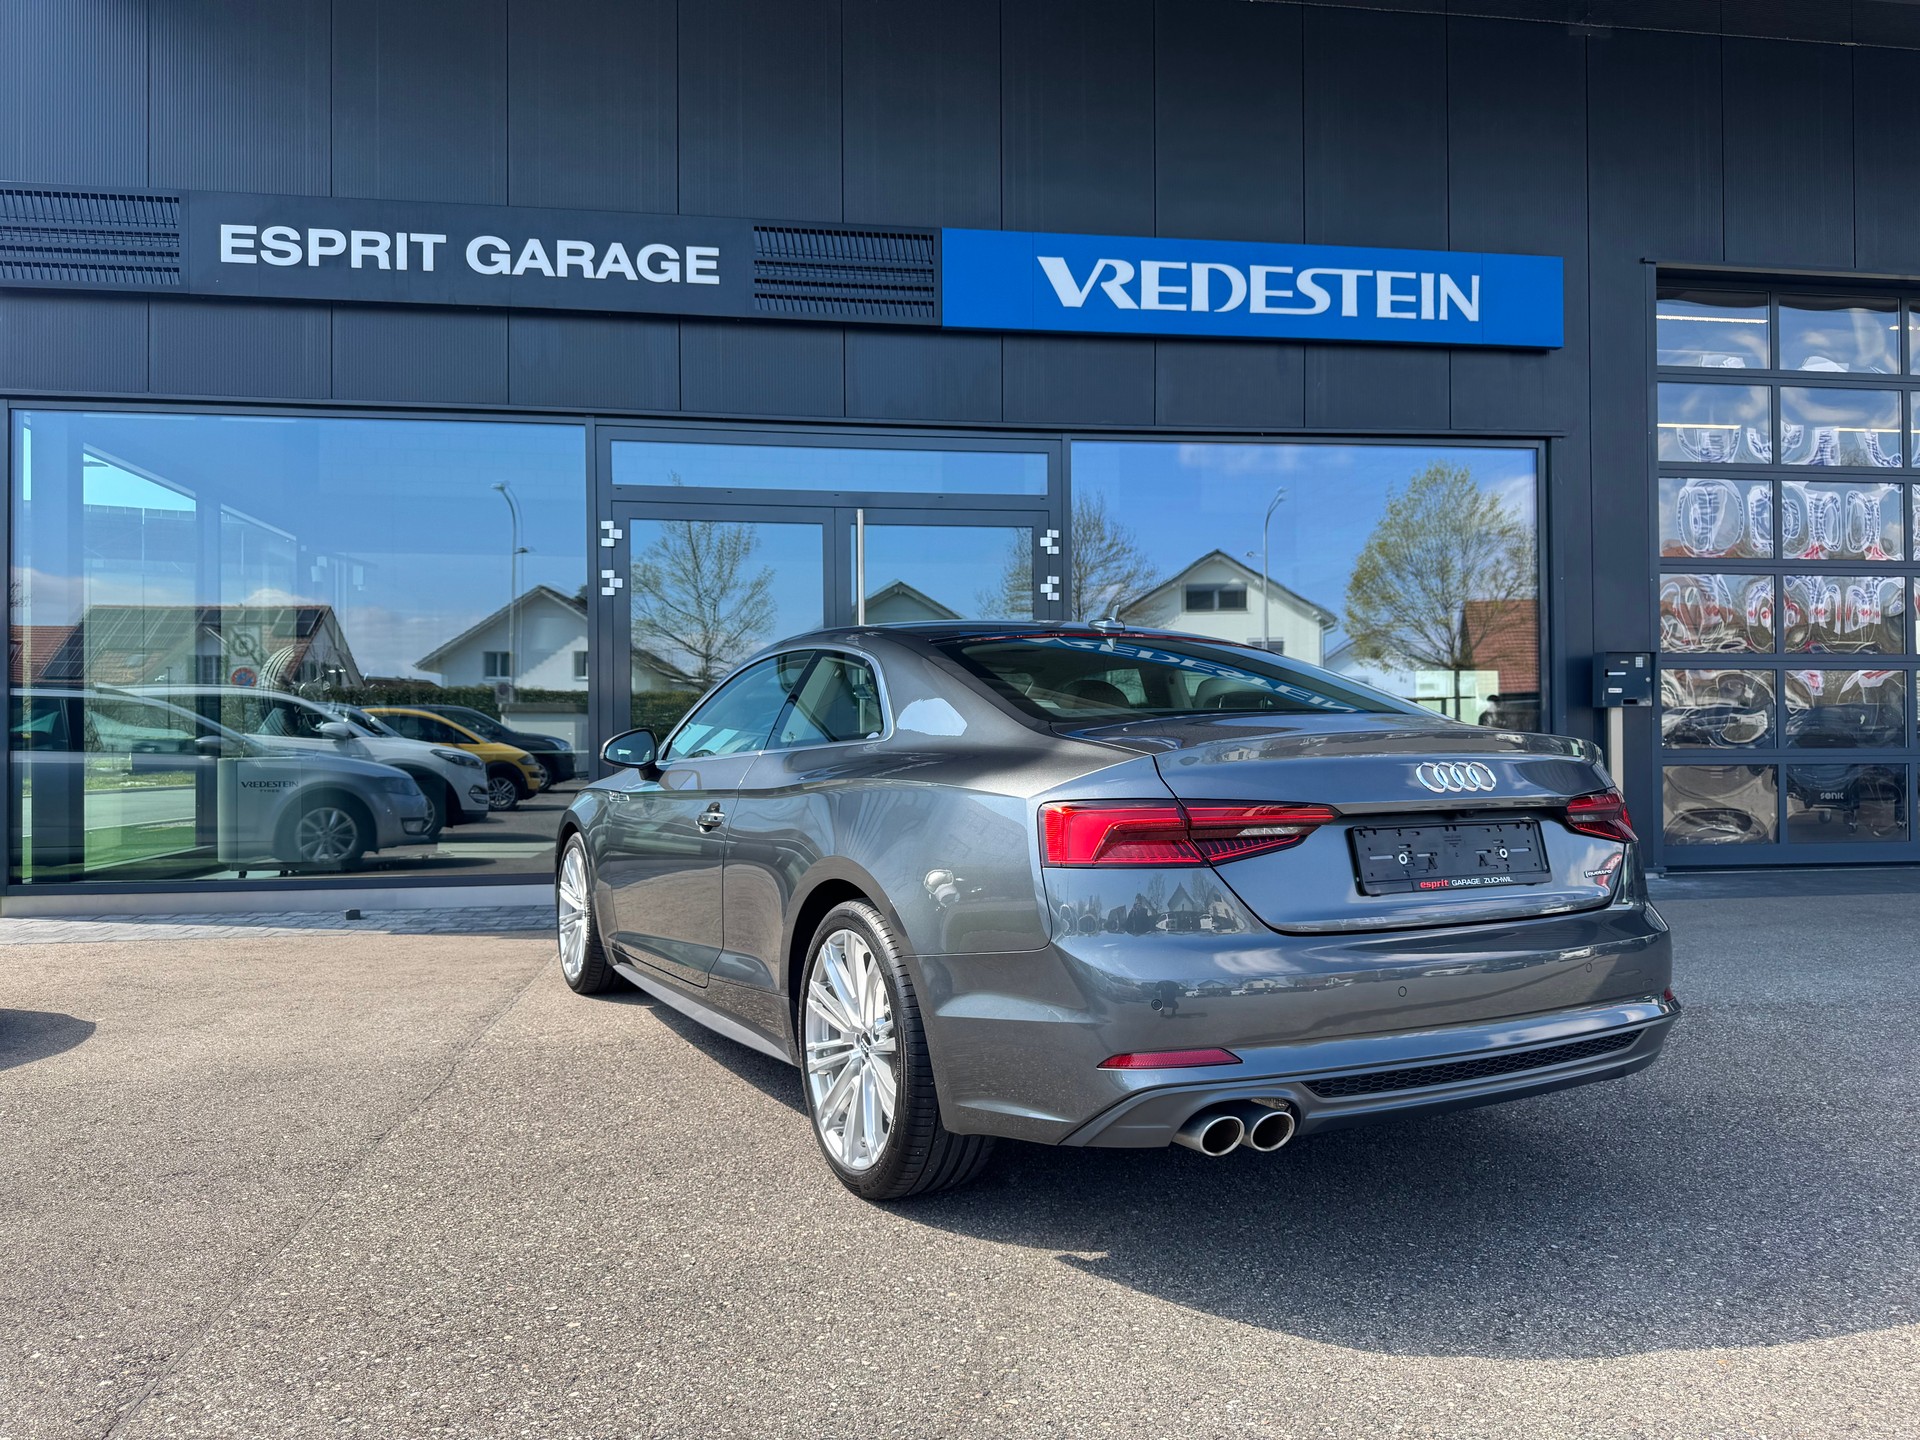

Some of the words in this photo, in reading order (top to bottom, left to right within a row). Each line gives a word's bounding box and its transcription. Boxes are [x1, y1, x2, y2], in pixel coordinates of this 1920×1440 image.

[220, 224, 446, 271] ESPRIT
[465, 235, 720, 285] GARAGE
[1037, 256, 1479, 322] VREDESTEIN
[241, 780, 298, 788] VREDESTEIN
[1587, 869, 1612, 877] quattro
[1420, 879, 1449, 889] esprit
[1451, 878, 1480, 886] GARAGE
[1484, 877, 1513, 885] ZUCHWIL
